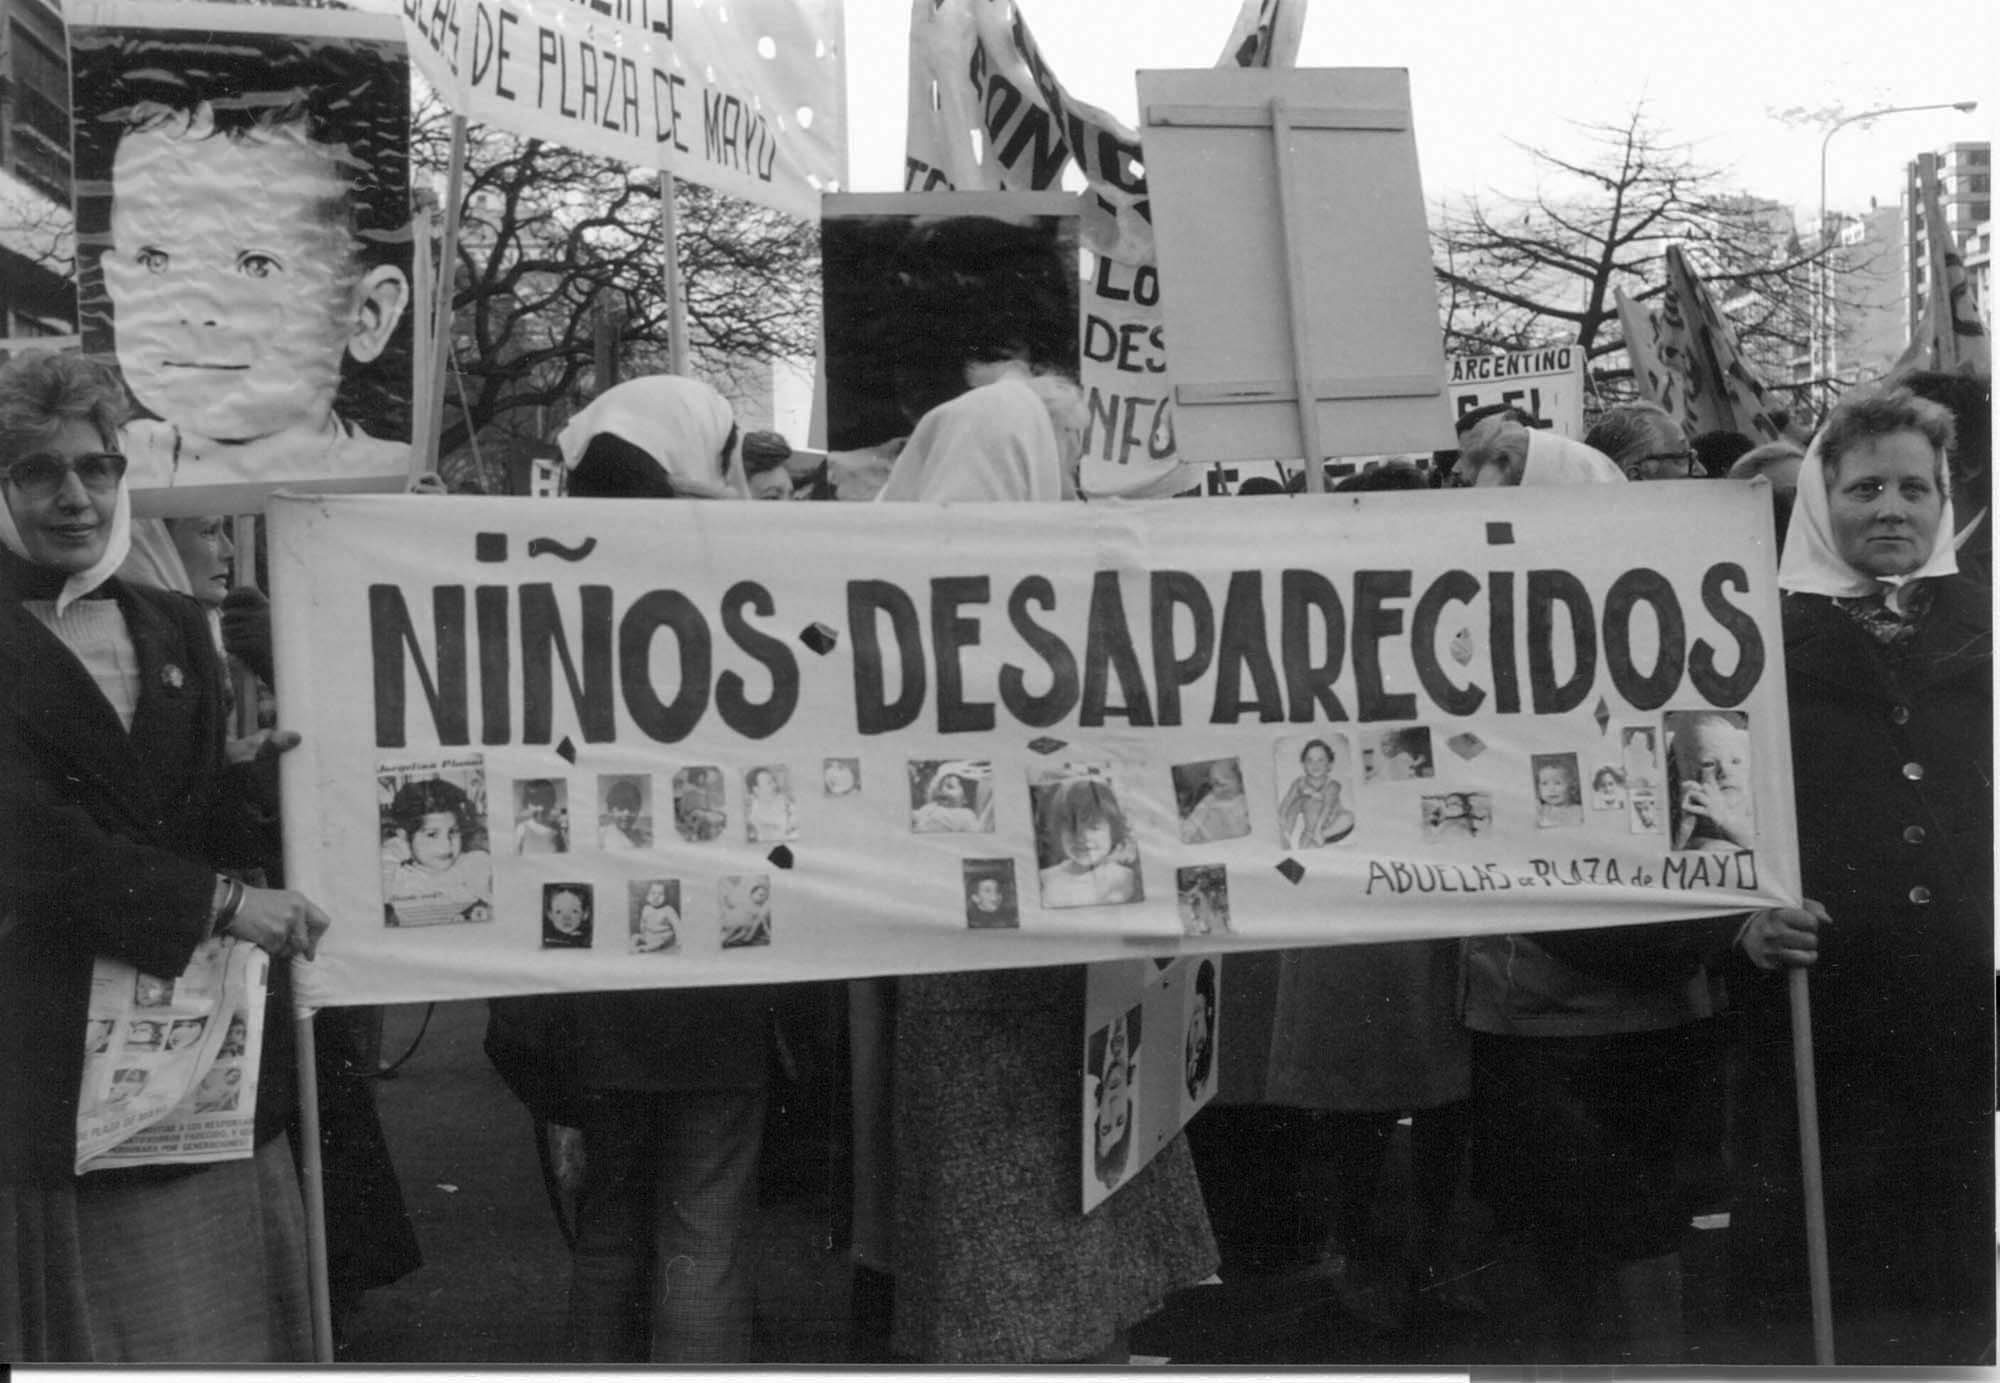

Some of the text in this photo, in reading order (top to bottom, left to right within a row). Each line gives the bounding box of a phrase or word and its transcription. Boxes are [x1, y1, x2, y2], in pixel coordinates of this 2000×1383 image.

[471, 2, 519, 100] DE
[538, 26, 640, 137] PLAZA
[703, 86, 777, 183] MAYO
[1451, 347, 1571, 382] ARGENTINO
[368, 521, 1766, 748] NIÑOS DESAPARECIDOS
[1365, 860, 1512, 895] ABUELAS
[1662, 849, 1759, 891] MAYO
